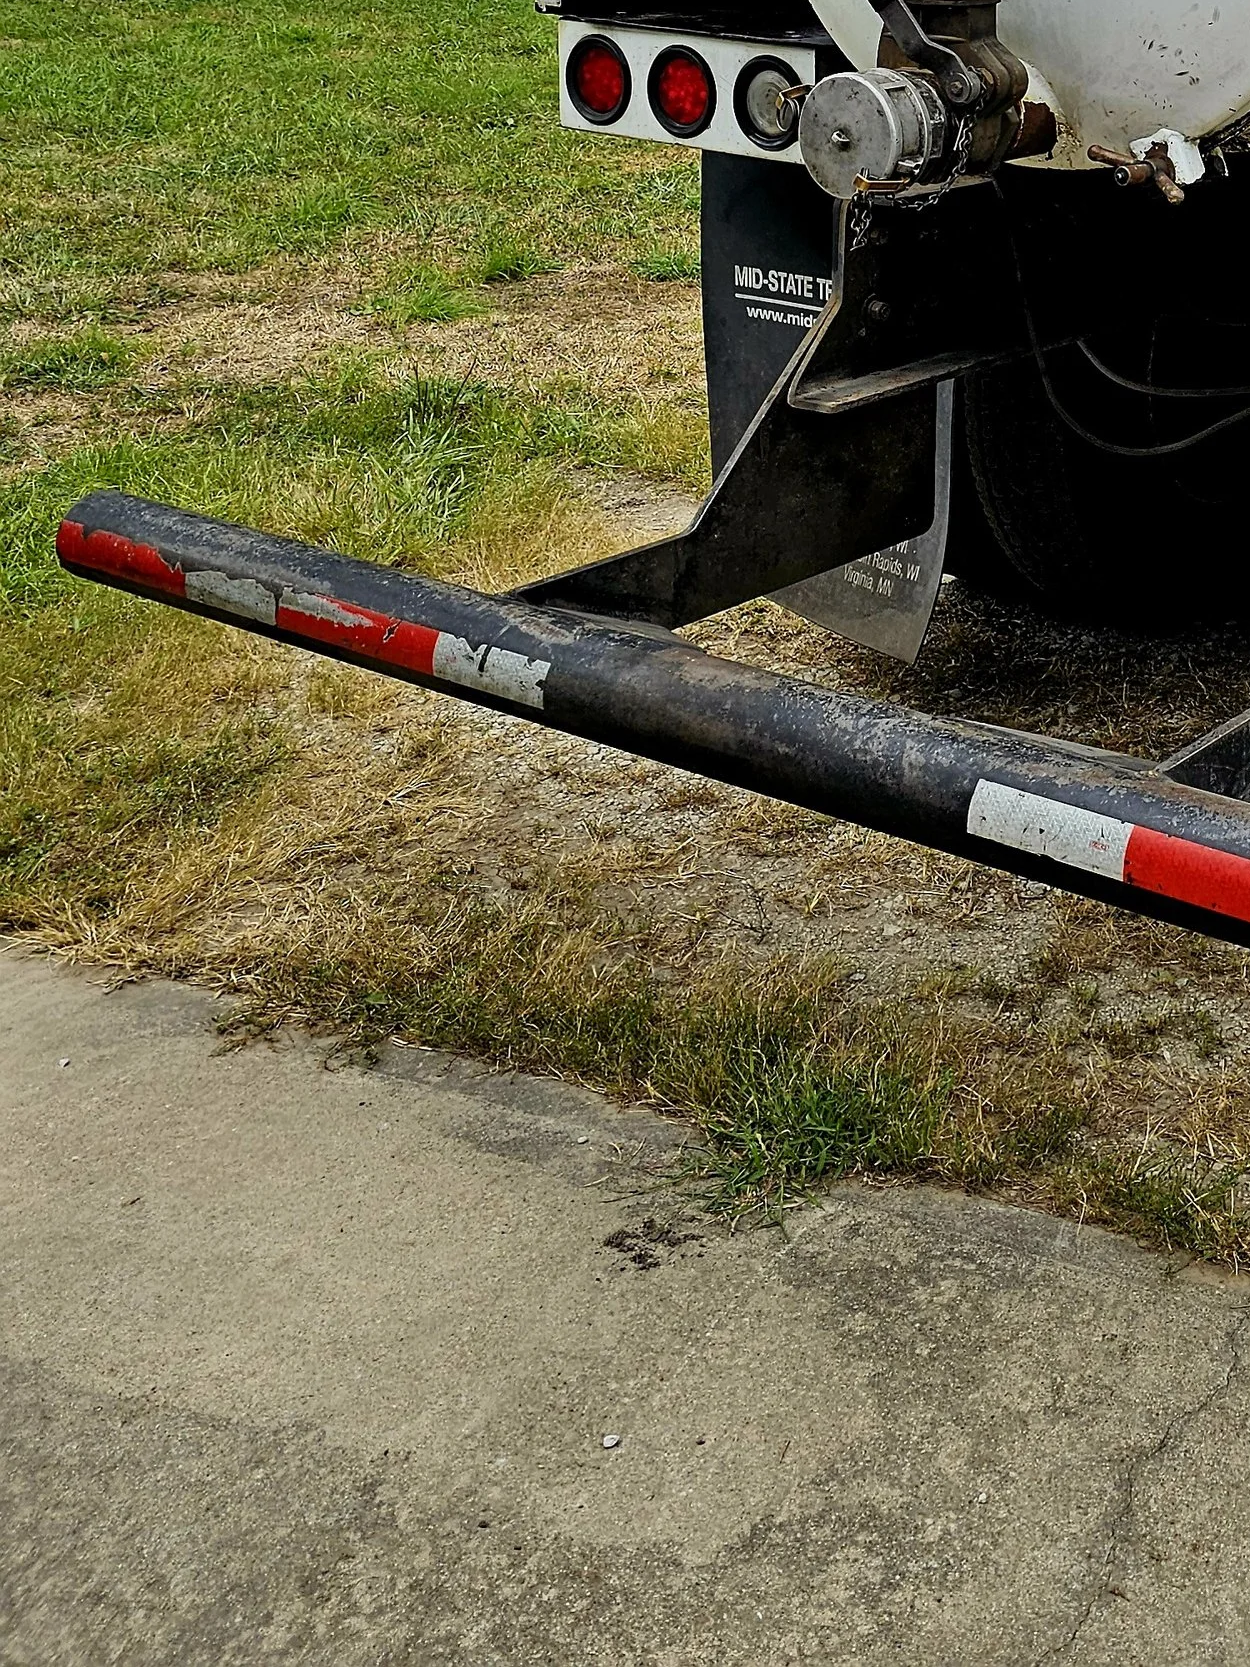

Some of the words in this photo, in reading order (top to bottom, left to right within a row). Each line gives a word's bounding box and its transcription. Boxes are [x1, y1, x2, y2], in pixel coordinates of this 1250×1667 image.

[734, 264, 813, 298] MID-STATE
[844, 564, 874, 593] Virginia,
[876, 577, 894, 597] MN
[872, 551, 903, 579] Rapids,
[906, 562, 920, 582] WI
